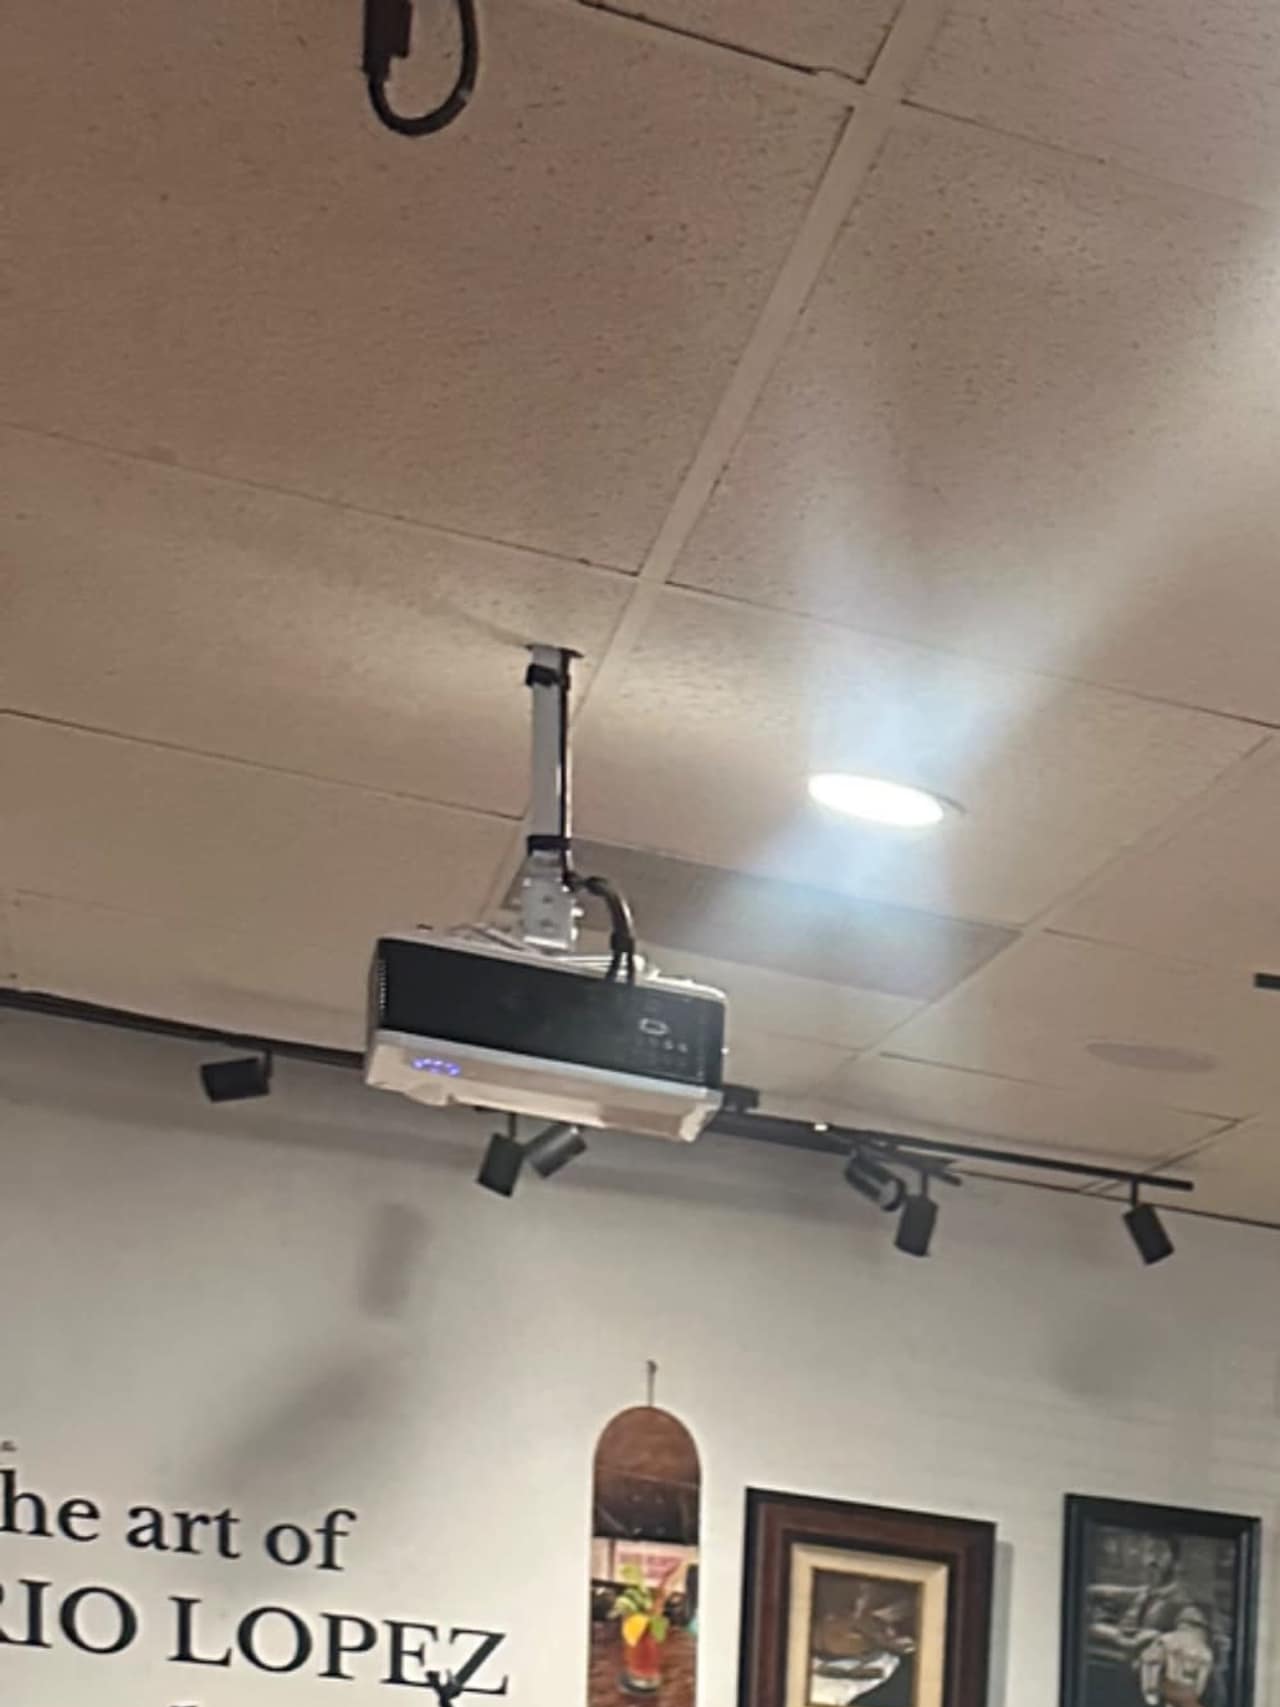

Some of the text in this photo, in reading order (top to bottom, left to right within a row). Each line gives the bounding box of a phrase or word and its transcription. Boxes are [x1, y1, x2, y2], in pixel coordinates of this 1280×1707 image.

[126, 1506, 241, 1560] art
[264, 1508, 358, 1571] of
[0, 1578, 509, 1696] IO LOPEZ
